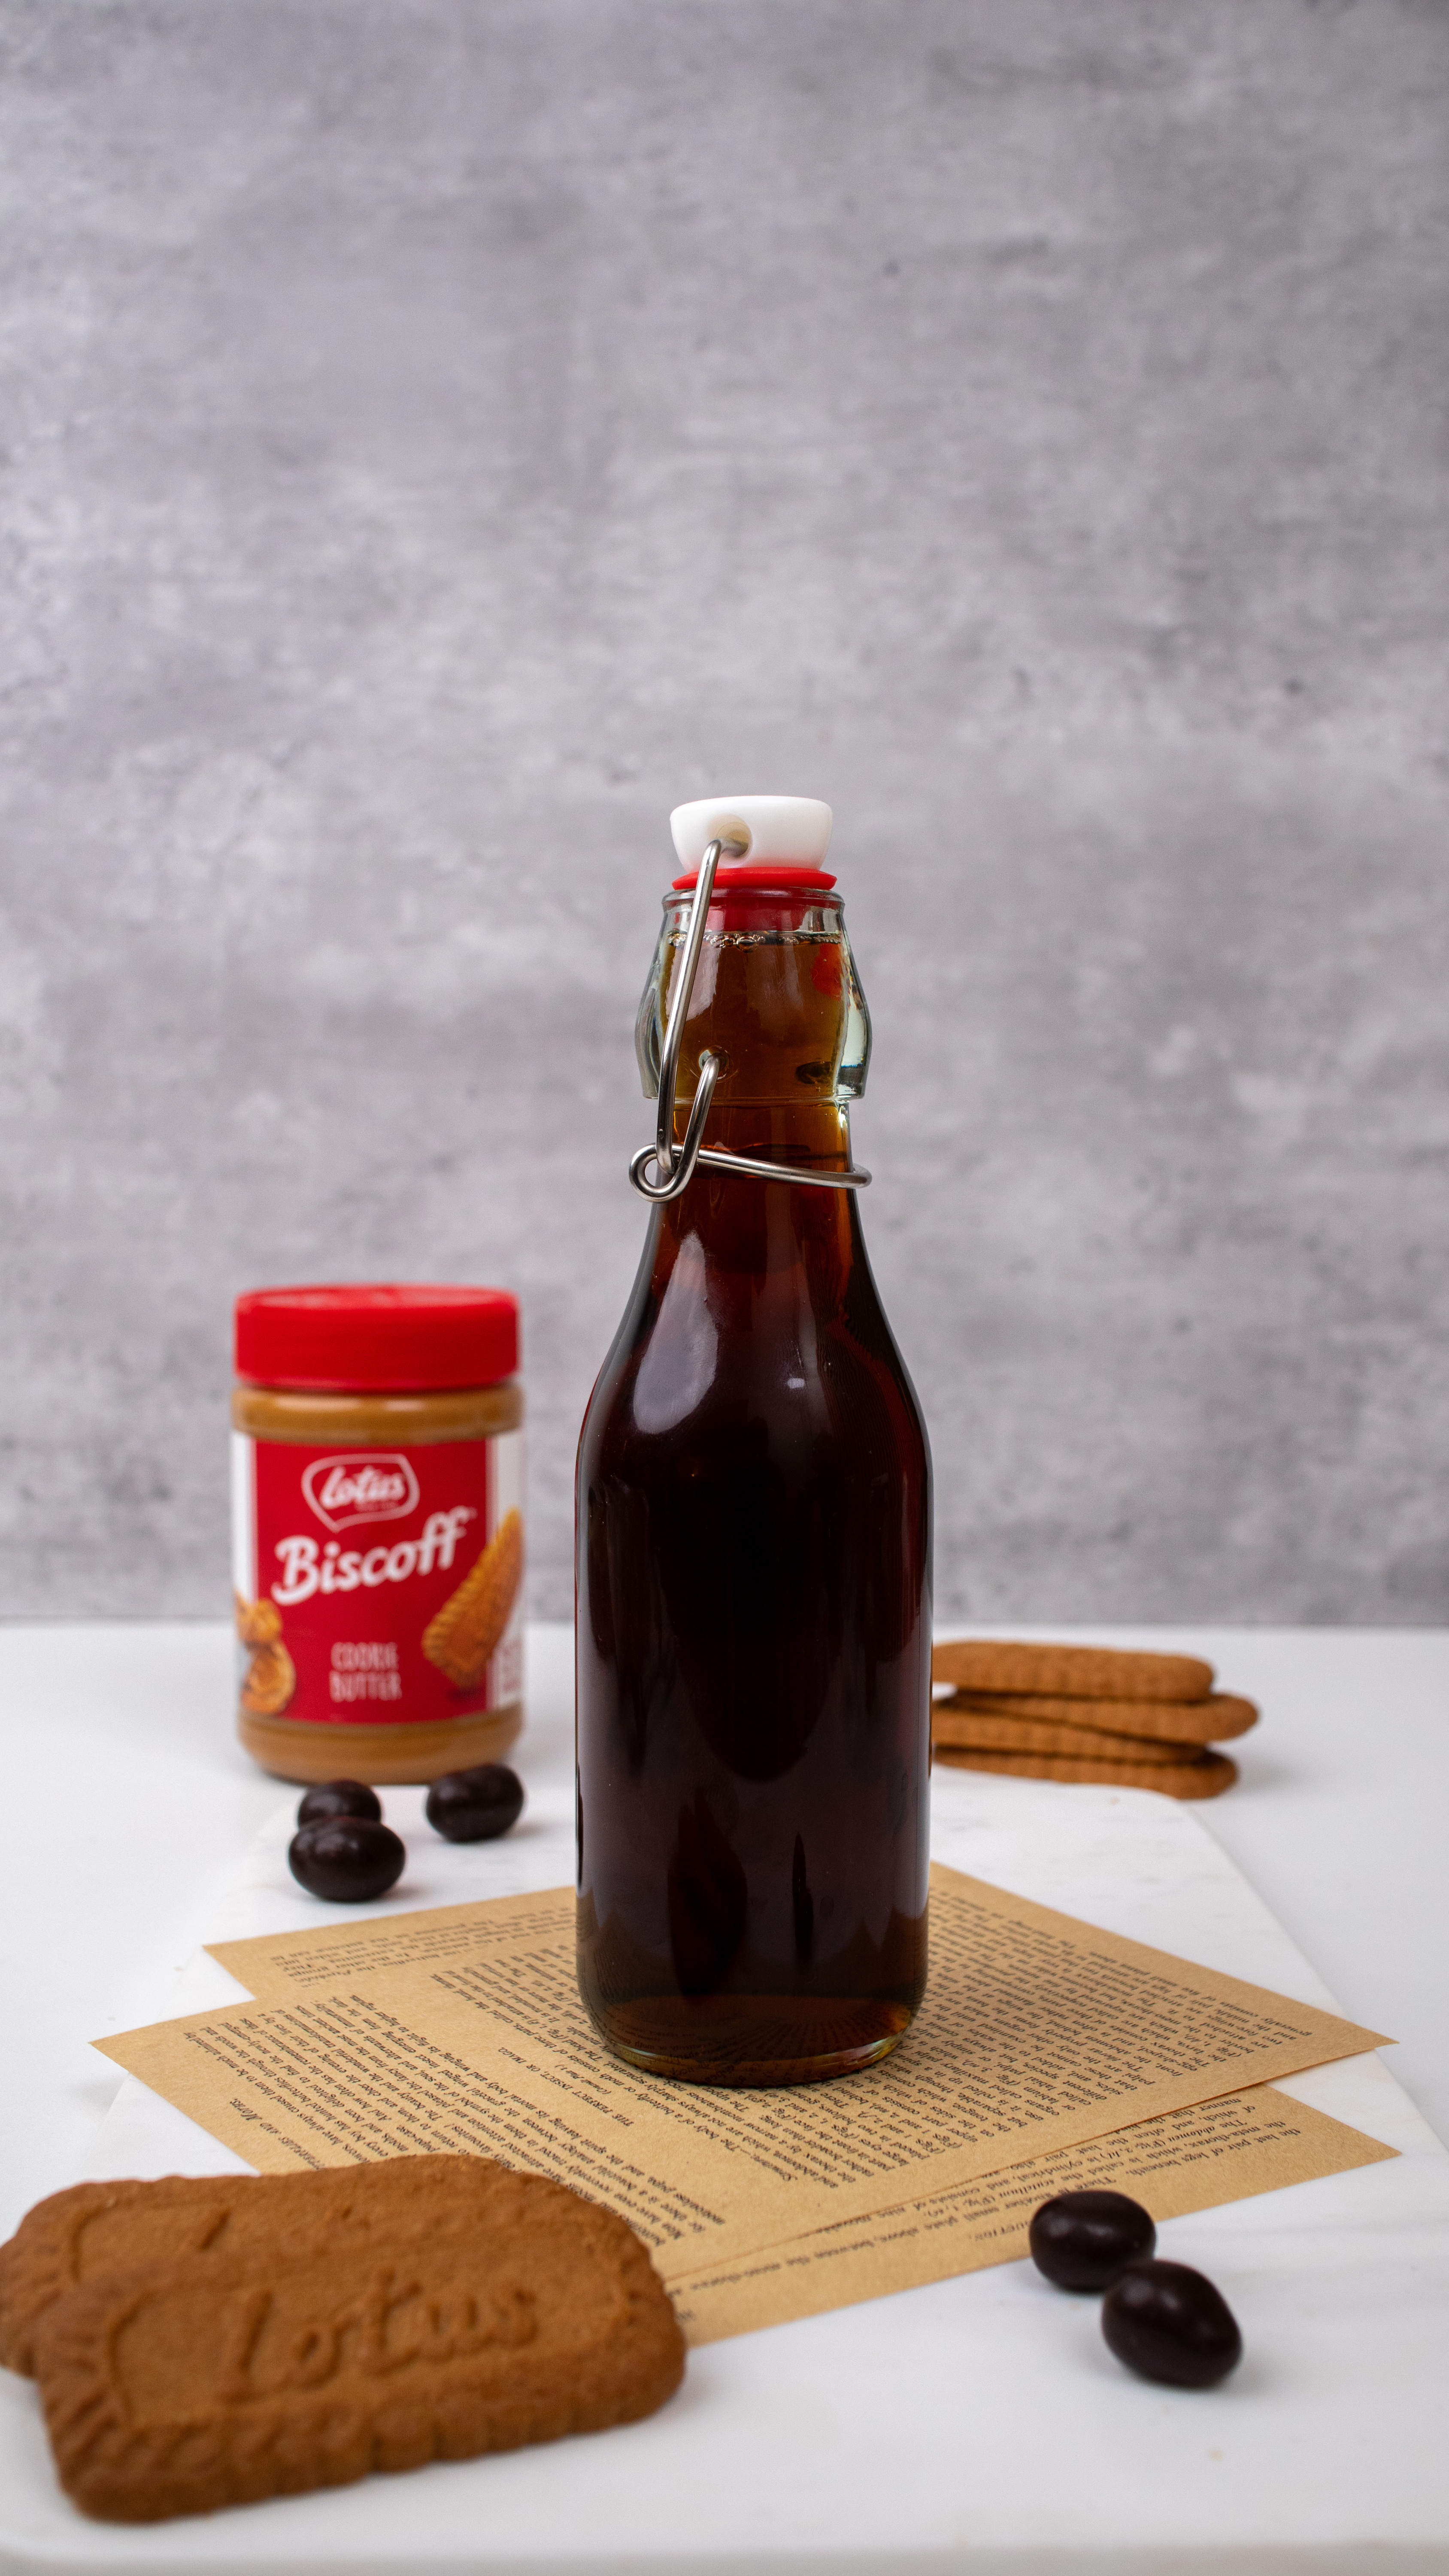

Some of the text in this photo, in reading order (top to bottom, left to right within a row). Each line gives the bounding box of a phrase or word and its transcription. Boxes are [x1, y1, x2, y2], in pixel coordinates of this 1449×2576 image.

[272, 1505, 471, 1605] Biscoff
[331, 1641, 399, 1671] COOKIE
[329, 1670, 403, 1703] BUTTER
[486, 2010, 514, 2023] called
[512, 2023, 539, 2035] parts,
[566, 2025, 602, 2044] movable.
[910, 2027, 942, 2038] palpi
[1199, 2022, 1246, 2040] attached
[406, 2032, 430, 2046] flight
[534, 2036, 557, 2048] three
[1109, 2025, 1210, 2067] The thorax consists
[1141, 2028, 1204, 2054] larva, which
[363, 2035, 402, 2060] afterwards
[940, 2040, 976, 2054] simply
[1055, 2045, 1080, 2055] only
[216, 2055, 239, 2068] much
[269, 2055, 284, 2064] the
[438, 2052, 470, 2071] winging
[498, 2047, 527, 2063] IMAGO.
[886, 2053, 922, 2066] spiral
[1082, 2056, 1101, 2064] the
[279, 2065, 300, 2075] find
[317, 2054, 347, 2073] evening
[397, 2060, 418, 2070] and
[567, 2055, 600, 2072] consists
[911, 2050, 989, 2084] maxillary palpi
[962, 2038, 1107, 2100] different species, but always
[993, 2062, 1026, 2075] palpi,
[264, 2035, 392, 2120] And how often has the remembrance
[345, 2074, 361, 2083] the
[381, 2031, 520, 2117] the graceful winged insect emerging
[414, 2070, 437, 2082] soul,
[466, 2072, 488, 2081] and
[540, 2071, 573, 2090] INSECT,
[599, 2073, 624, 2086] moth
[1122, 2073, 1156, 2085] palpi
[255, 2081, 276, 2095] them
[330, 2048, 443, 2121] The beauty and the wonderful
[358, 2084, 381, 2096] cheer
[433, 2082, 449, 2090] the
[485, 2082, 508, 2095] body
[561, 2039, 743, 2136] are not always sharply separated. The head
[846, 2080, 864, 2088] the
[1024, 2076, 1057, 2091] labial
[235, 2049, 366, 2142] boy has hunted butterflies through the
[305, 2084, 345, 2107] delighted
[355, 2046, 506, 2142] attention and pleased the fancy from the
[701, 2084, 749, 2112] The upper
[877, 2070, 988, 2121] tongue, which consists
[883, 2060, 1028, 2127] but separable, through which
[961, 2085, 996, 2099] rolled
[1057, 2091, 1091, 2105] called
[269, 2095, 299, 2113] caused
[376, 2097, 398, 2108] and
[454, 2097, 490, 2114] symbol
[503, 2094, 537, 2110] mortal
[571, 2091, 613, 2113] PERFECT
[634, 2093, 675, 2114] butterfly
[659, 2079, 744, 2122] membranous neck,
[882, 2096, 920, 2114] consists
[344, 2108, 365, 2122] been
[397, 2107, 420, 2123] them,
[487, 2114, 504, 2123] the
[535, 2110, 550, 2118] its
[612, 2114, 634, 2126] THE
[297, 2113, 324, 2130] always
[361, 2123, 382, 2133] and
[548, 2117, 582, 2140] leaving
[1171, 2120, 1194, 2130] and
[321, 2131, 343, 2145] have
[693, 2125, 719, 2139] body
[1133, 2128, 1164, 2138] often
[1183, 2126, 1261, 2148] meta-thorax,
[1253, 2134, 1280, 2143] last
[580, 2139, 606, 2154] spirit
[1227, 2139, 1252, 2150] pair
[1146, 2147, 1182, 2159] which
